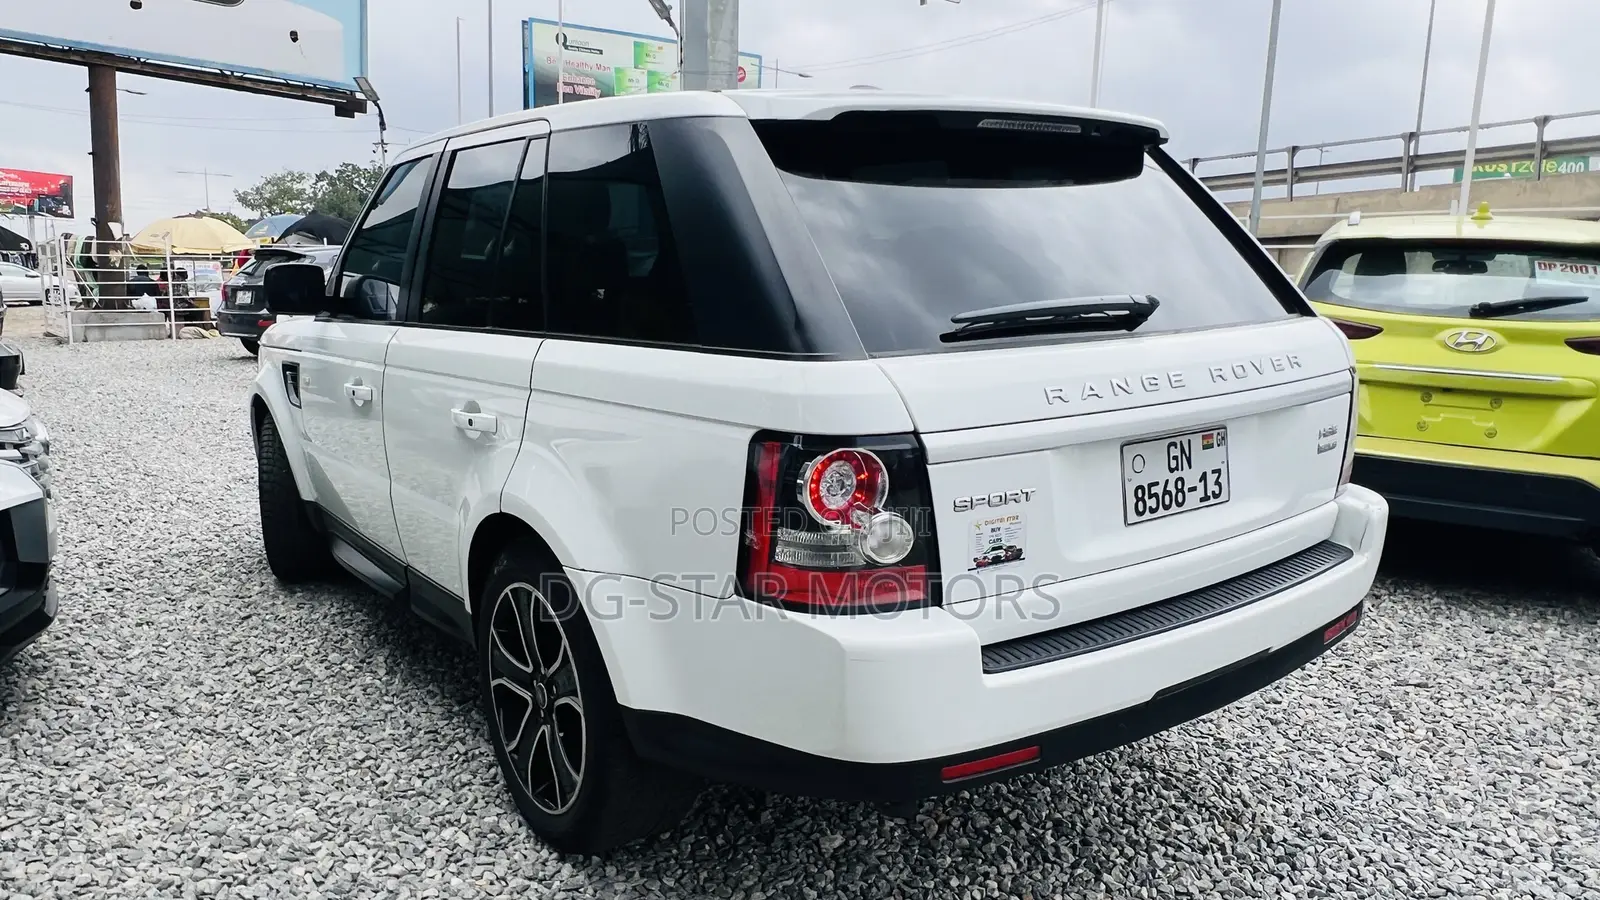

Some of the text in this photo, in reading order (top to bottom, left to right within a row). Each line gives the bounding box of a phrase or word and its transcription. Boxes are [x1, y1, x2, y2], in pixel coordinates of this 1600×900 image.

[565, 60, 594, 70] Healthy
[1557, 161, 1585, 174] 400
[1560, 264, 1598, 275] 2001
[1044, 354, 1303, 405] RANGE ROVER
[1216, 432, 1226, 448] GH
[1167, 438, 1192, 474] GN
[953, 488, 1037, 513] SPORT
[1133, 468, 1223, 517] 8568-13
